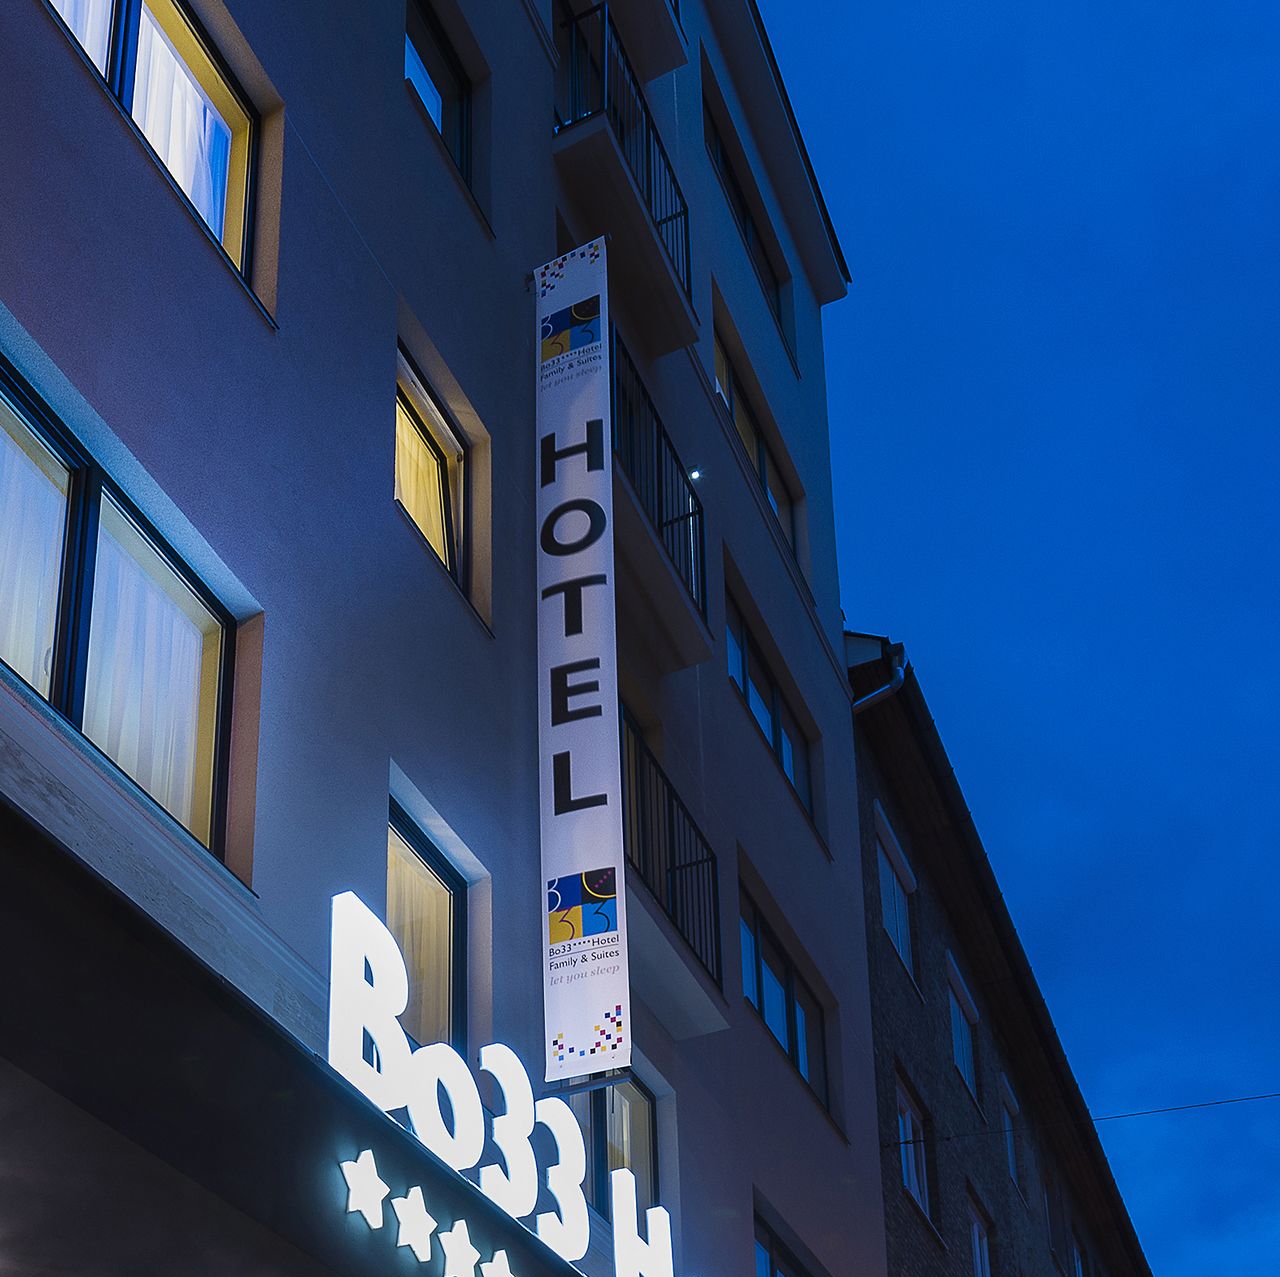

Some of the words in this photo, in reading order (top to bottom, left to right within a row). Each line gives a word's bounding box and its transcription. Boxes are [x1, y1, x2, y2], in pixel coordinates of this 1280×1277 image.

[540, 366, 565, 382] Family
[567, 361, 574, 370] &
[576, 353, 602, 367] Suites
[539, 419, 608, 816] HOTEL
[592, 934, 620, 946] Hotel
[549, 956, 578, 971] Family
[580, 953, 588, 963] &
[591, 948, 620, 961] Suites
[550, 975, 564, 986] let
[566, 969, 588, 984] you
[590, 964, 620, 977] sleep
[328, 890, 591, 1262] Bo33
